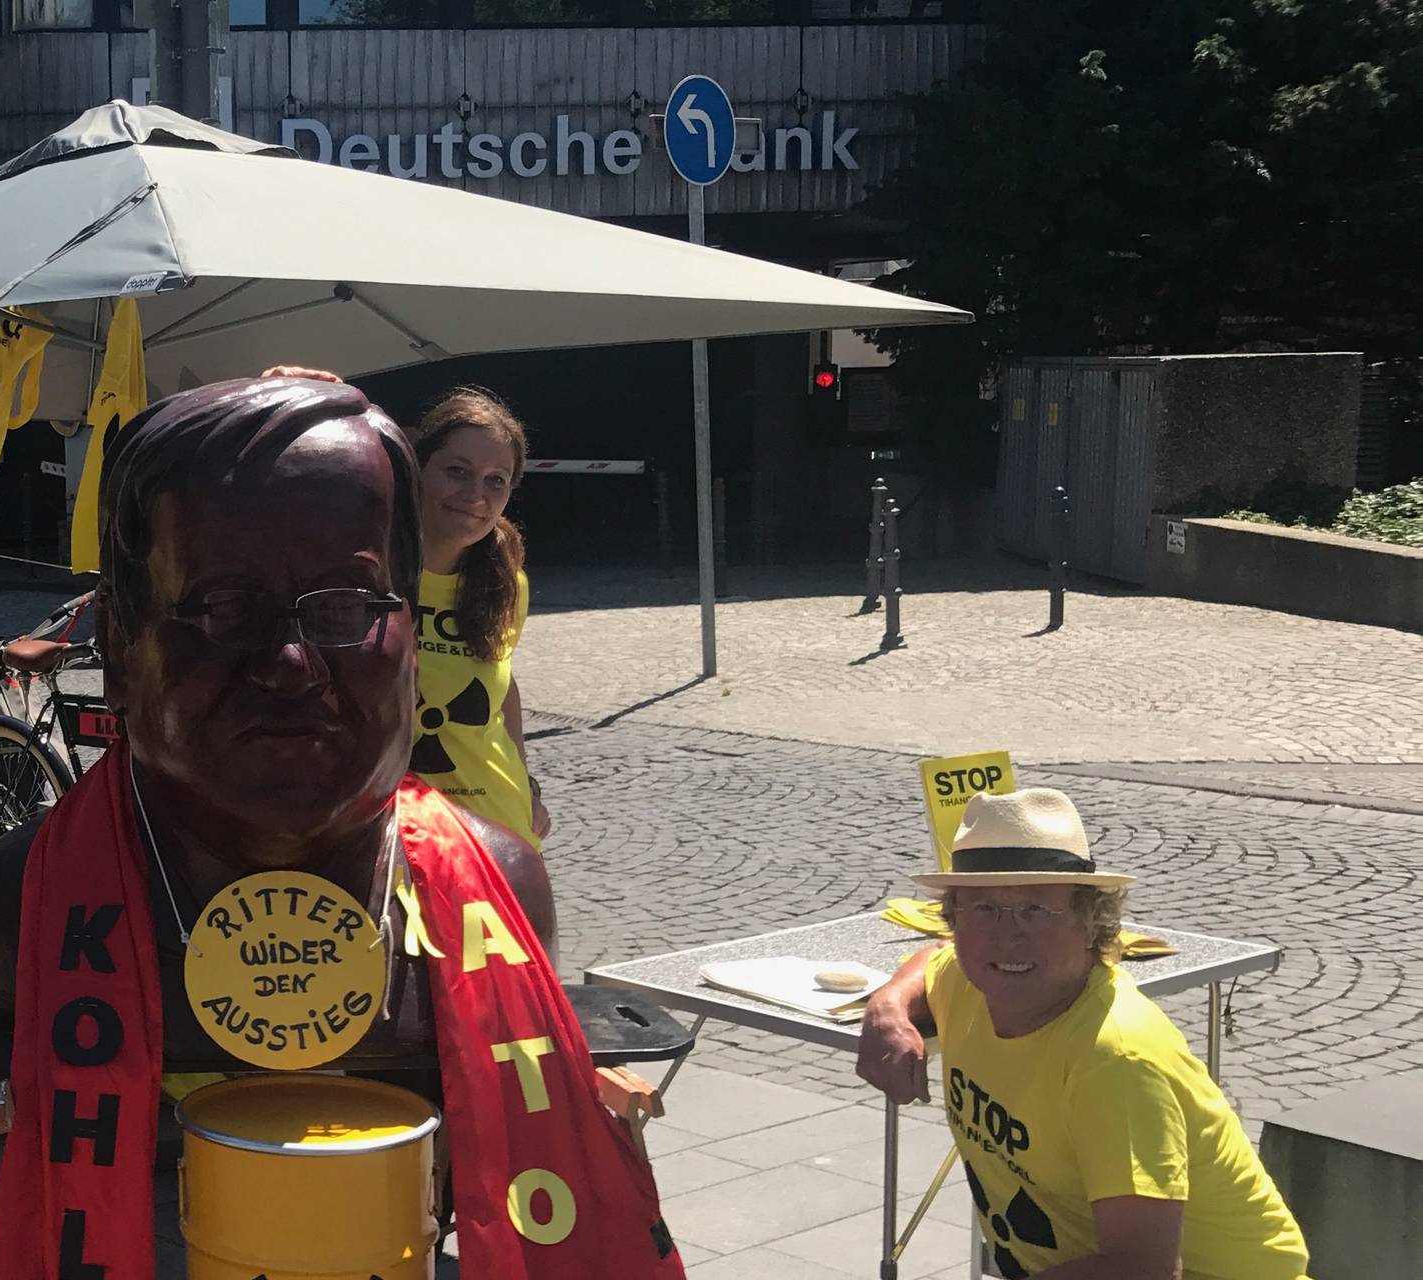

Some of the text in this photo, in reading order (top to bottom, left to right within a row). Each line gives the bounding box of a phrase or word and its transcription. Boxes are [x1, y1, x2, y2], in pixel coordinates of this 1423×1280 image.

[280, 111, 859, 178] Deutsche ank
[934, 766, 1002, 796] STOP
[253, 972, 317, 997] DEN
[949, 1067, 1030, 1156] STOP
